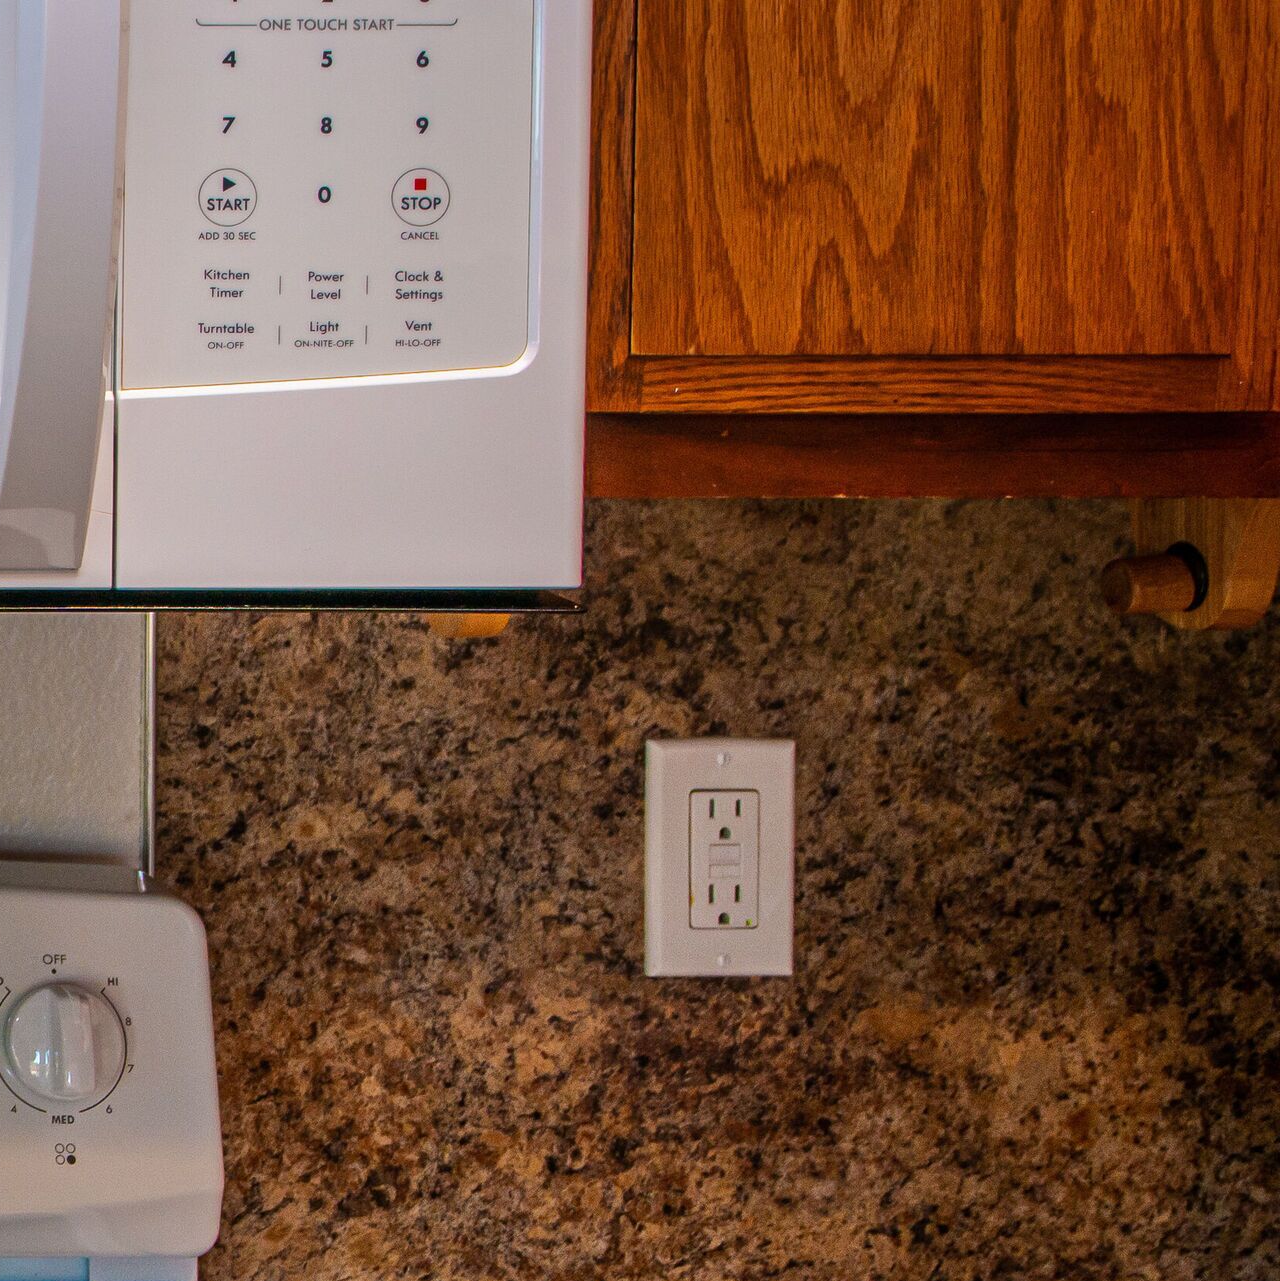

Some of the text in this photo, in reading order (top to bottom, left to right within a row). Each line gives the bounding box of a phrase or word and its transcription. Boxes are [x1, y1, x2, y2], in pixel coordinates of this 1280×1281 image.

[259, 19, 395, 31] ONE TOUCH START
[222, 51, 237, 68] 4
[321, 51, 333, 68] 5
[416, 51, 430, 68] 6
[222, 117, 235, 134] 7
[320, 117, 333, 134] 8
[416, 117, 429, 134] 9
[318, 187, 332, 203] 0
[206, 198, 250, 212] START
[400, 197, 442, 210] STOP
[198, 231, 256, 241] ADD 30 SEC
[400, 231, 440, 241] CANCEL
[204, 270, 250, 281] Kitchen
[308, 271, 344, 283] Power
[395, 270, 444, 283] Clock &
[210, 287, 244, 299] Timer
[310, 288, 341, 301] Level
[395, 288, 443, 302] Settings
[197, 322, 255, 335] Turntable
[309, 321, 340, 334] Light
[405, 321, 432, 332] Vent
[207, 341, 244, 350] ON-OFF
[294, 339, 354, 348] ON-NITE-OFF
[395, 339, 441, 347] HI-LO-OFF
[42, 954, 67, 965] OFF
[107, 977, 119, 986] HI
[125, 1017, 132, 1026] 8
[127, 1064, 135, 1073] 7
[10, 1105, 18, 1113] 4
[106, 1105, 113, 1114] 6
[51, 1115, 75, 1124] MED
